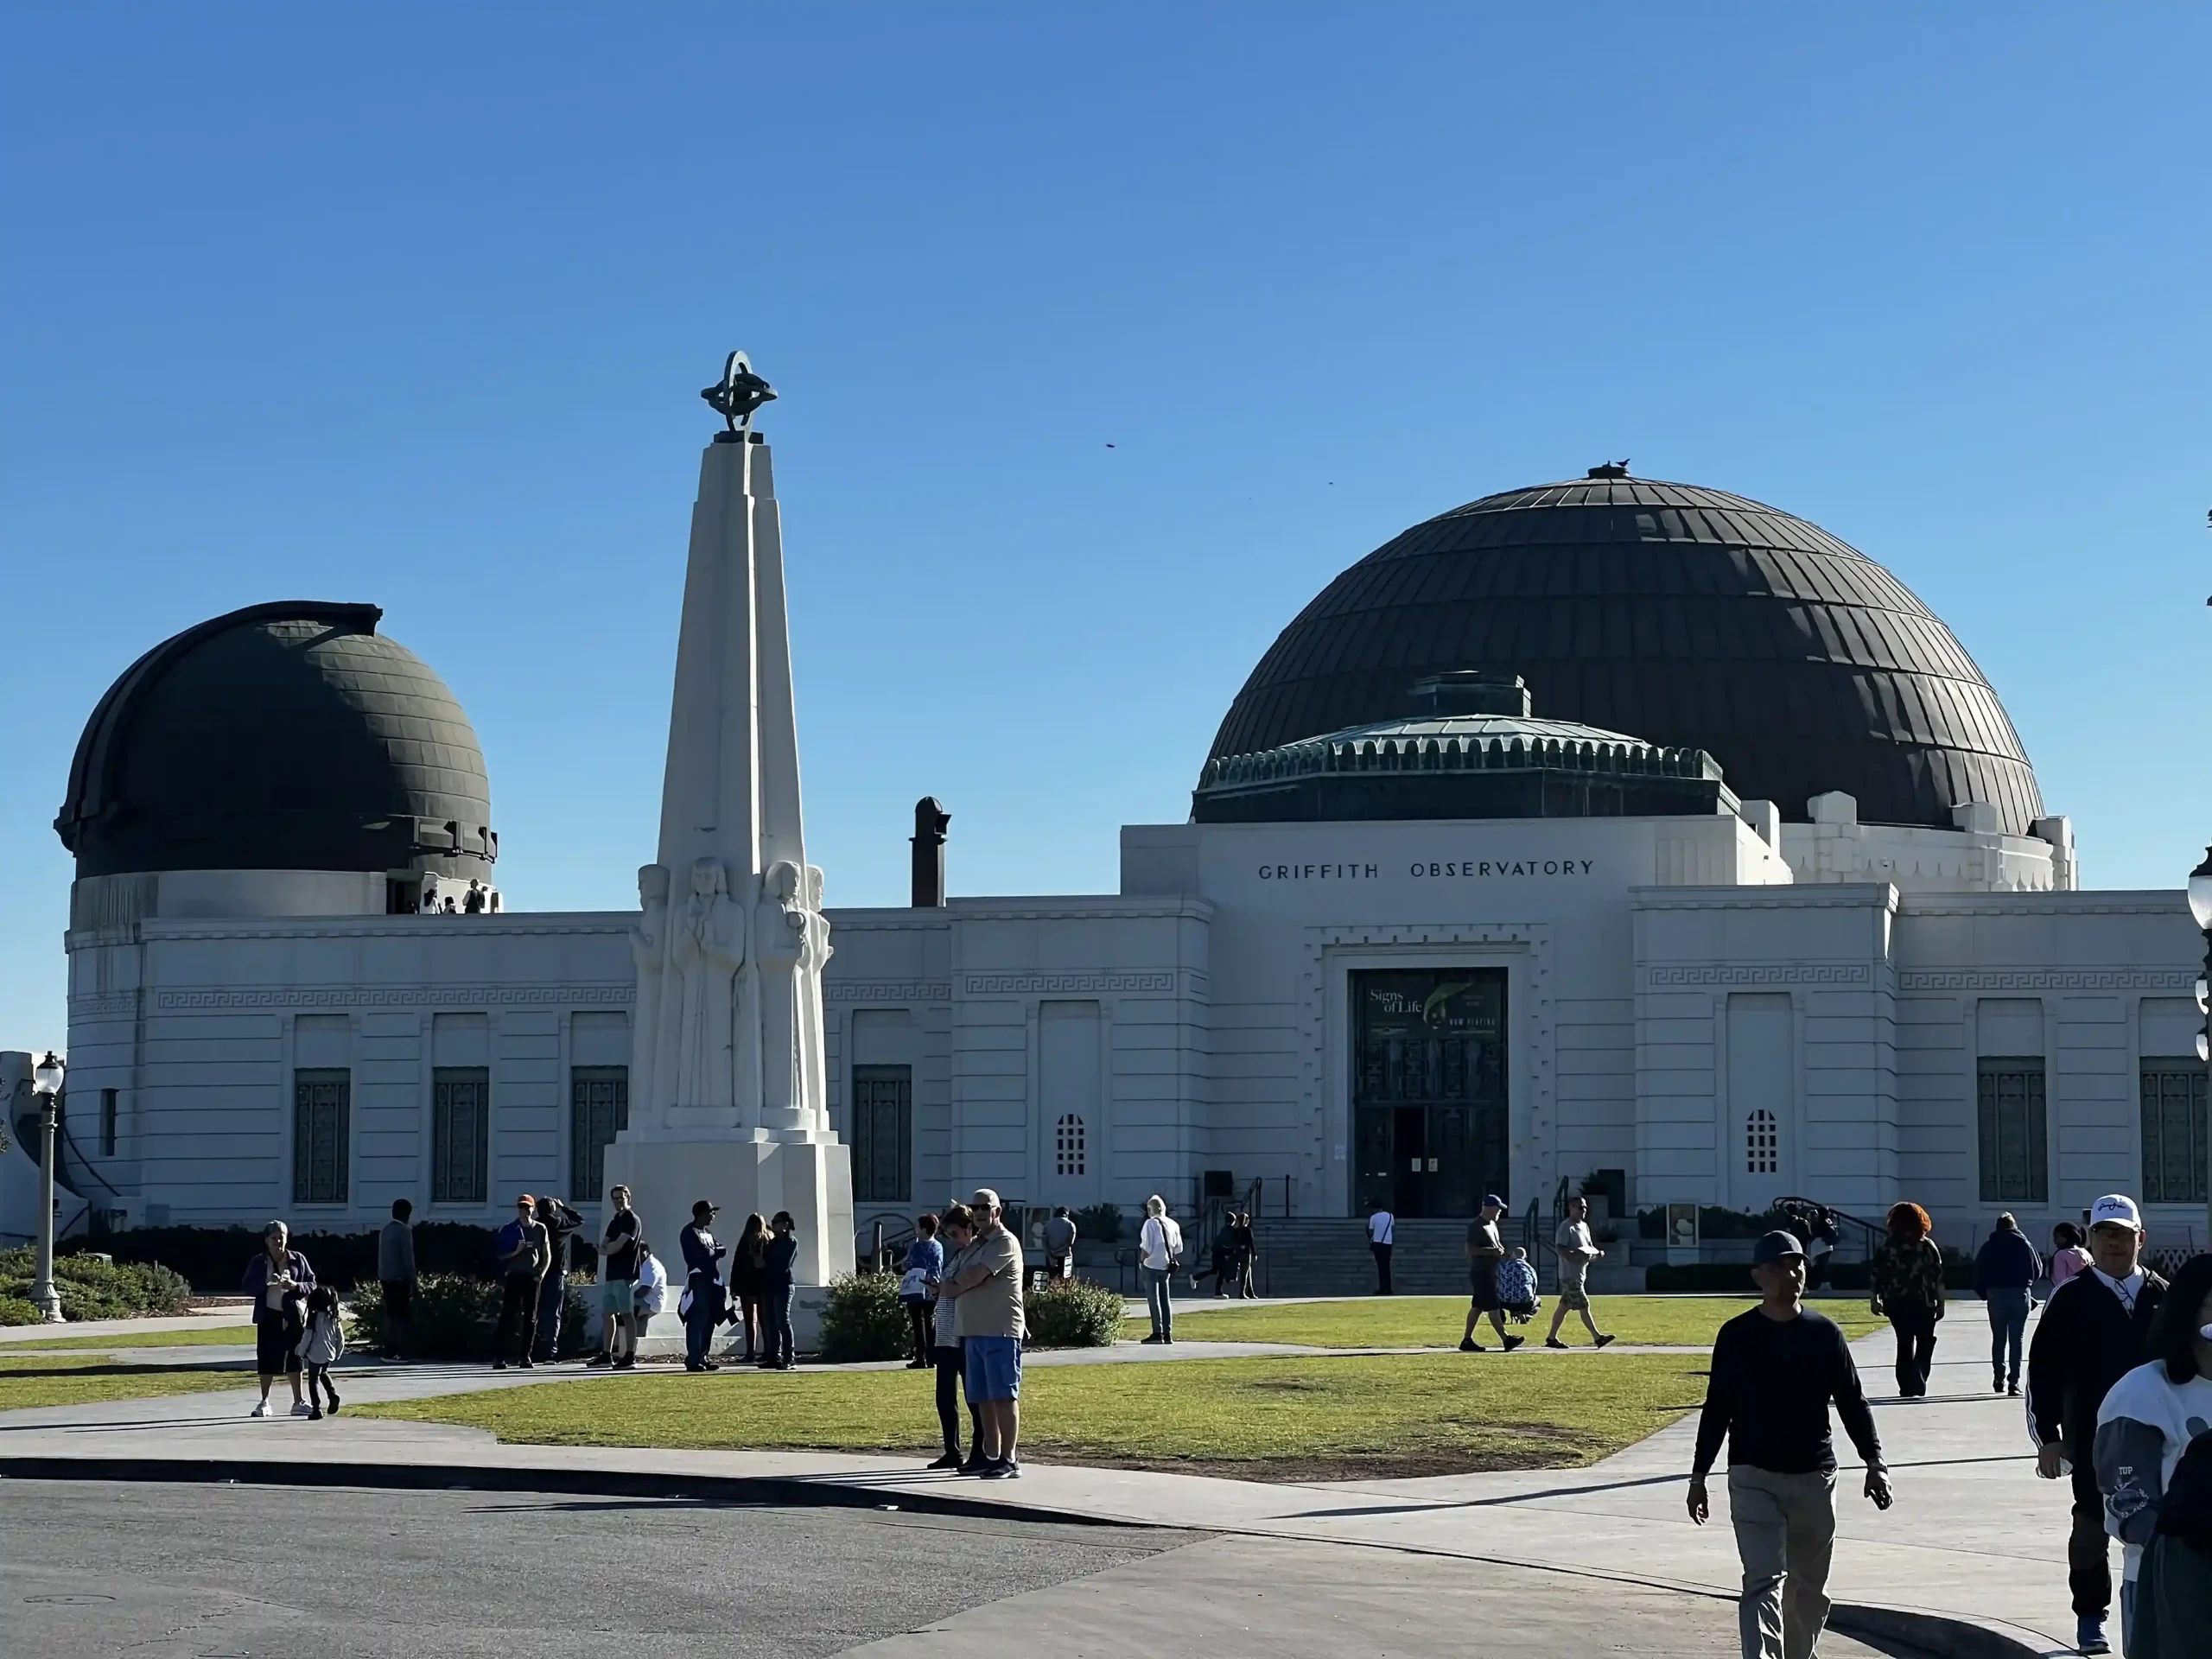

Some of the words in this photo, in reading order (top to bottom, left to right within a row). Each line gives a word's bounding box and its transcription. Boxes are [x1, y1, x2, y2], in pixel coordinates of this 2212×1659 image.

[1258, 863, 1378, 880] GRIFFITH
[1410, 860, 1593, 877] OBSERVATORY
[1370, 989, 1403, 1004] Signs
[1384, 1000, 1398, 1013] of
[1398, 1001, 1422, 1013] Life
[2119, 1466, 2133, 1475] TOP
